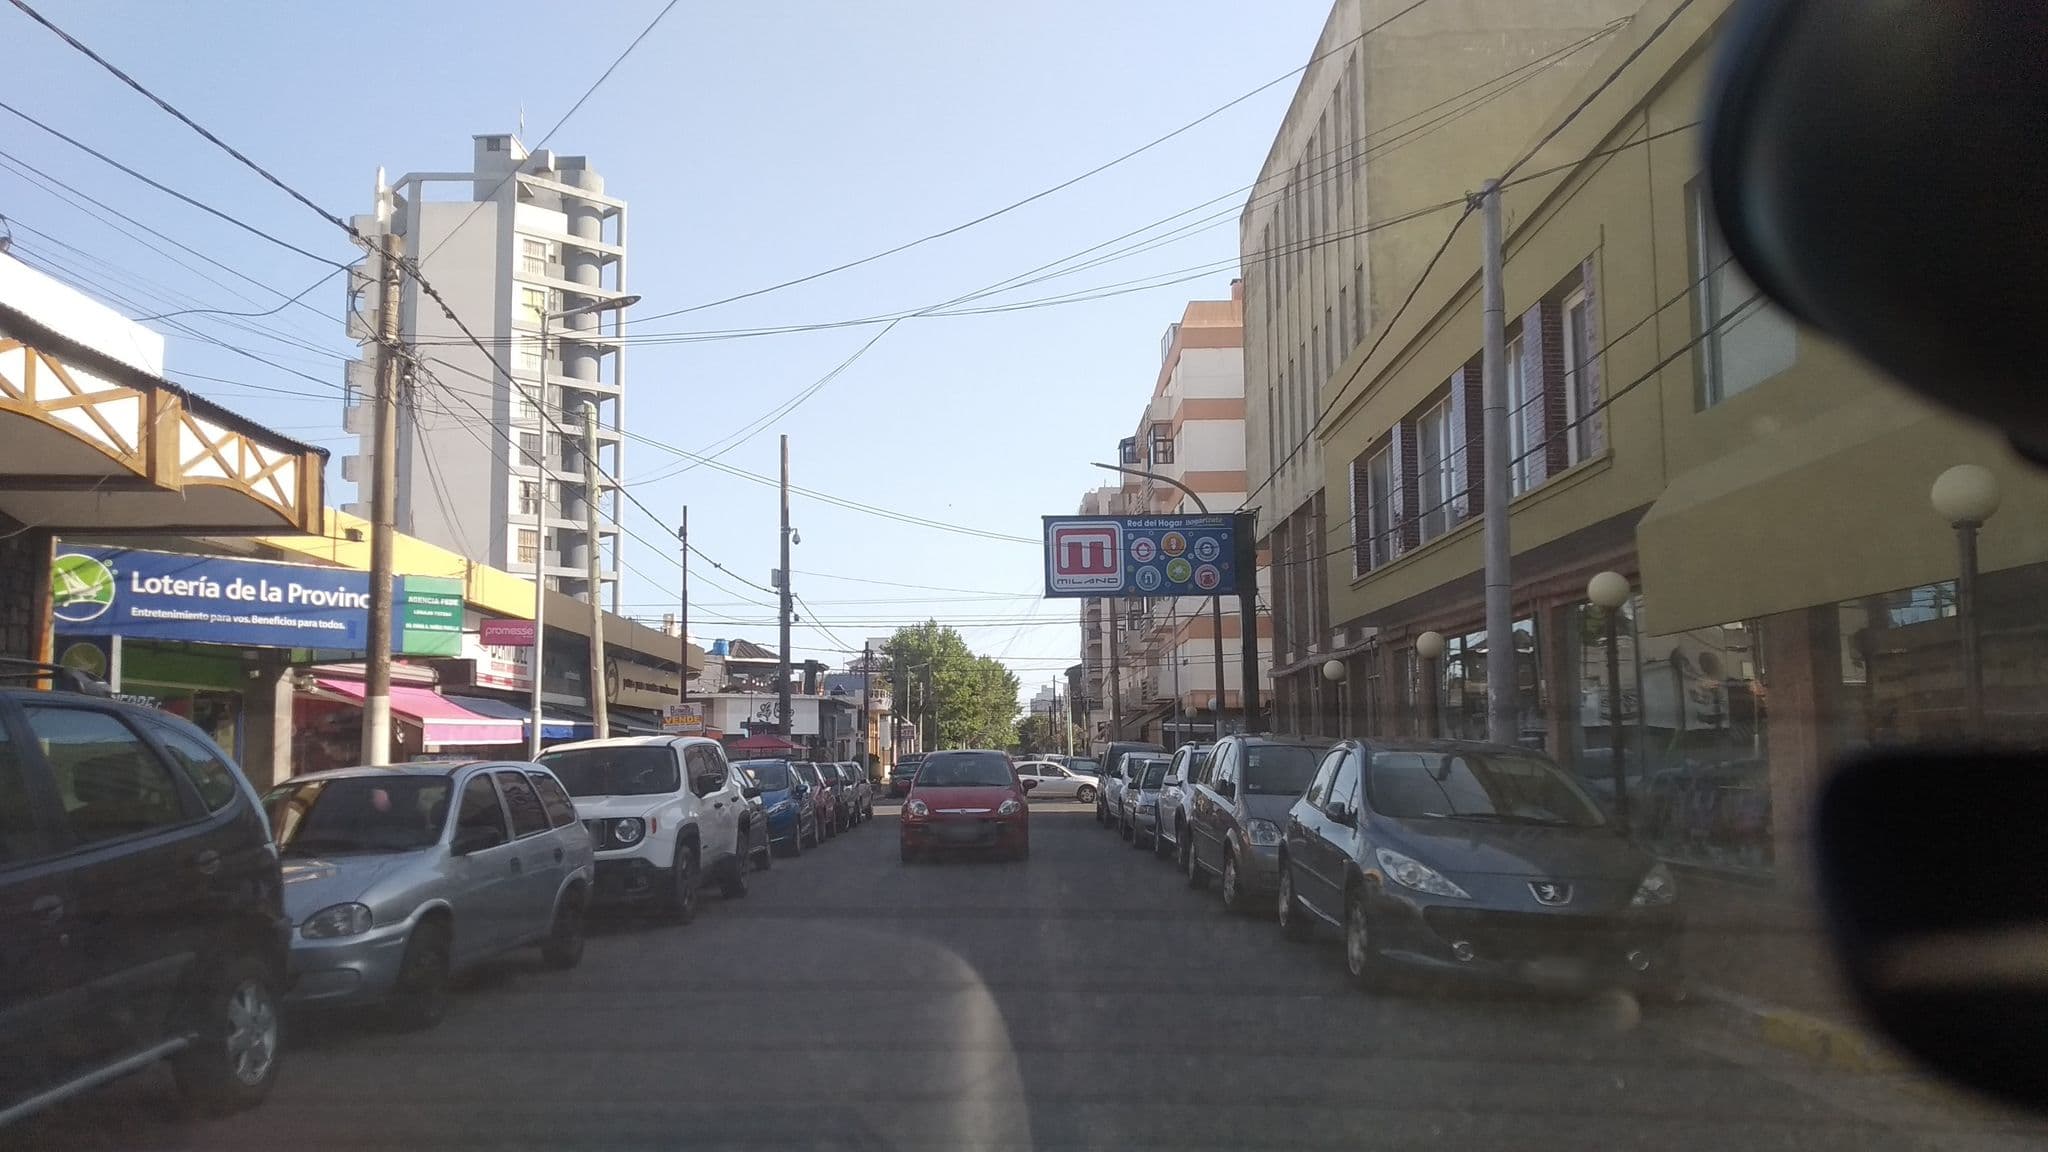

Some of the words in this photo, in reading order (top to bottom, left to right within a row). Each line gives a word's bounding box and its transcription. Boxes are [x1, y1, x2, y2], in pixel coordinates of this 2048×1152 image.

[1127, 519, 1142, 527] Red
[1144, 519, 1157, 527] del
[1158, 519, 1183, 528] Hogar
[131, 570, 220, 598] Lotería
[225, 577, 257, 601] de
[260, 579, 282, 603] la
[1057, 577, 1118, 585] MILANO
[131, 606, 209, 621] Entretenimiento
[210, 612, 232, 623] para
[233, 615, 252, 624] vos.
[251, 614, 297, 627] Beneficios
[297, 618, 319, 629] para
[319, 619, 346, 630] todos.
